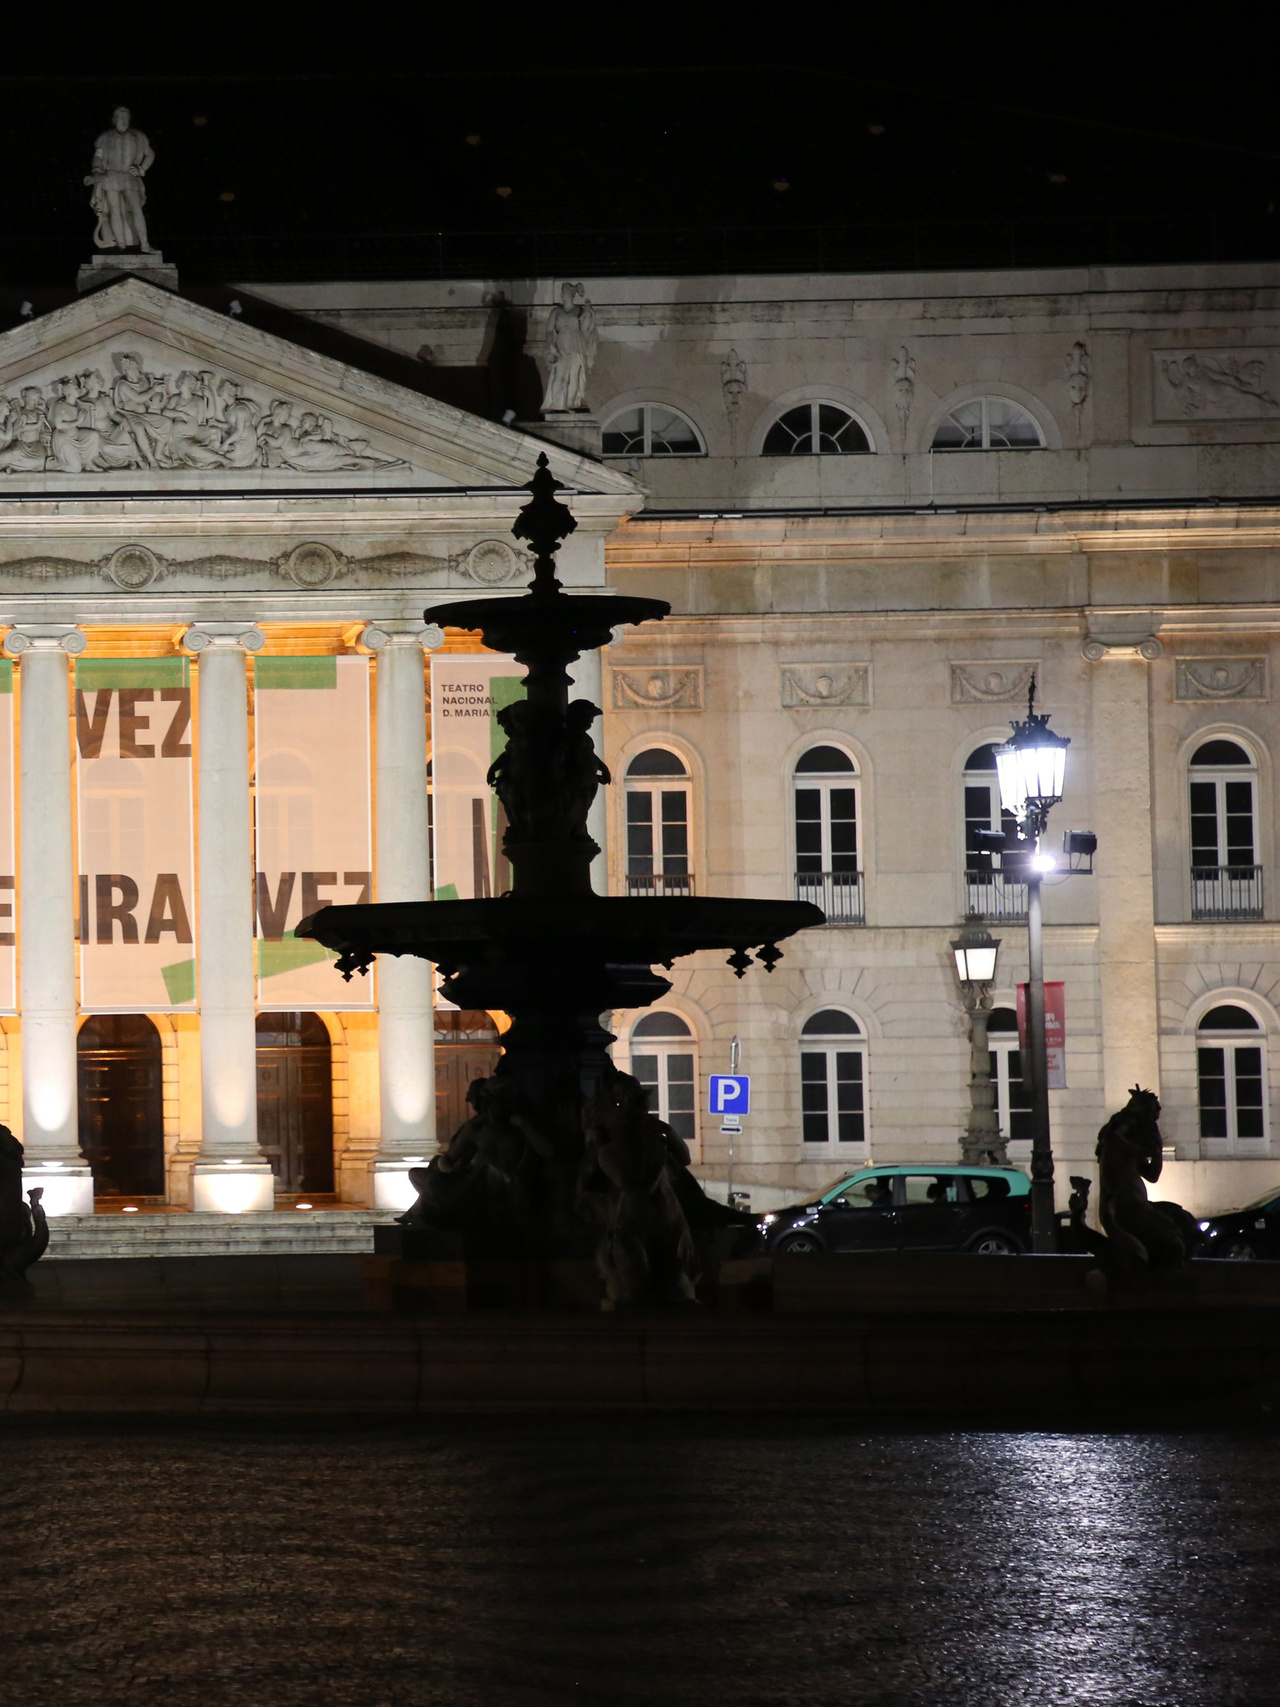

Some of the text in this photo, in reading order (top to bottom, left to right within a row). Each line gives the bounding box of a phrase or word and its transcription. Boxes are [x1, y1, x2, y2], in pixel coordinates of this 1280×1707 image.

[441, 684, 484, 692] TEATRO
[442, 696, 498, 704] NACIONAL
[455, 709, 489, 717] MARIA
[76, 687, 192, 759] VEZ
[717, 1079, 741, 1111] P
